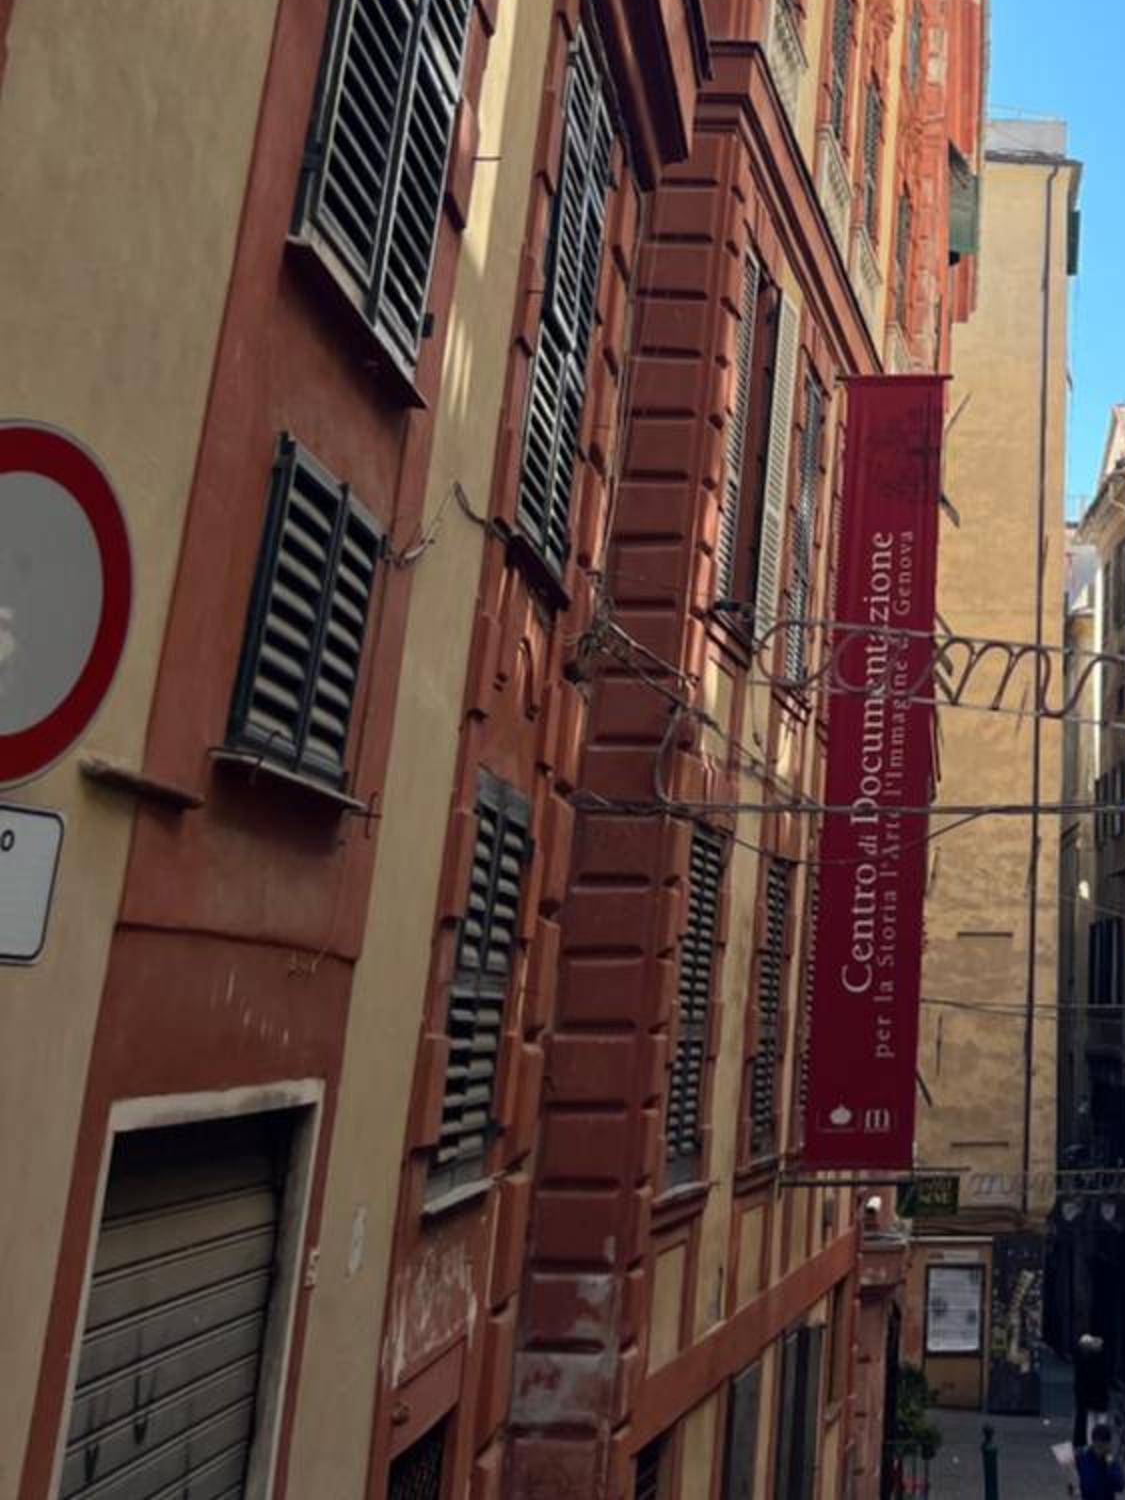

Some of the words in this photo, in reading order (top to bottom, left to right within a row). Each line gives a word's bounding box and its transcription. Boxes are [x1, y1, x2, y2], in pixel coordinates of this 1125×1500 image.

[892, 530, 914, 616] Genova
[849, 531, 893, 824] Documentazione
[884, 659, 912, 796] l'Immagine
[857, 834, 878, 856] di
[841, 863, 878, 995] Centro
[877, 891, 898, 967] Storia
[873, 981, 895, 1003] la
[874, 1017, 894, 1059] per
